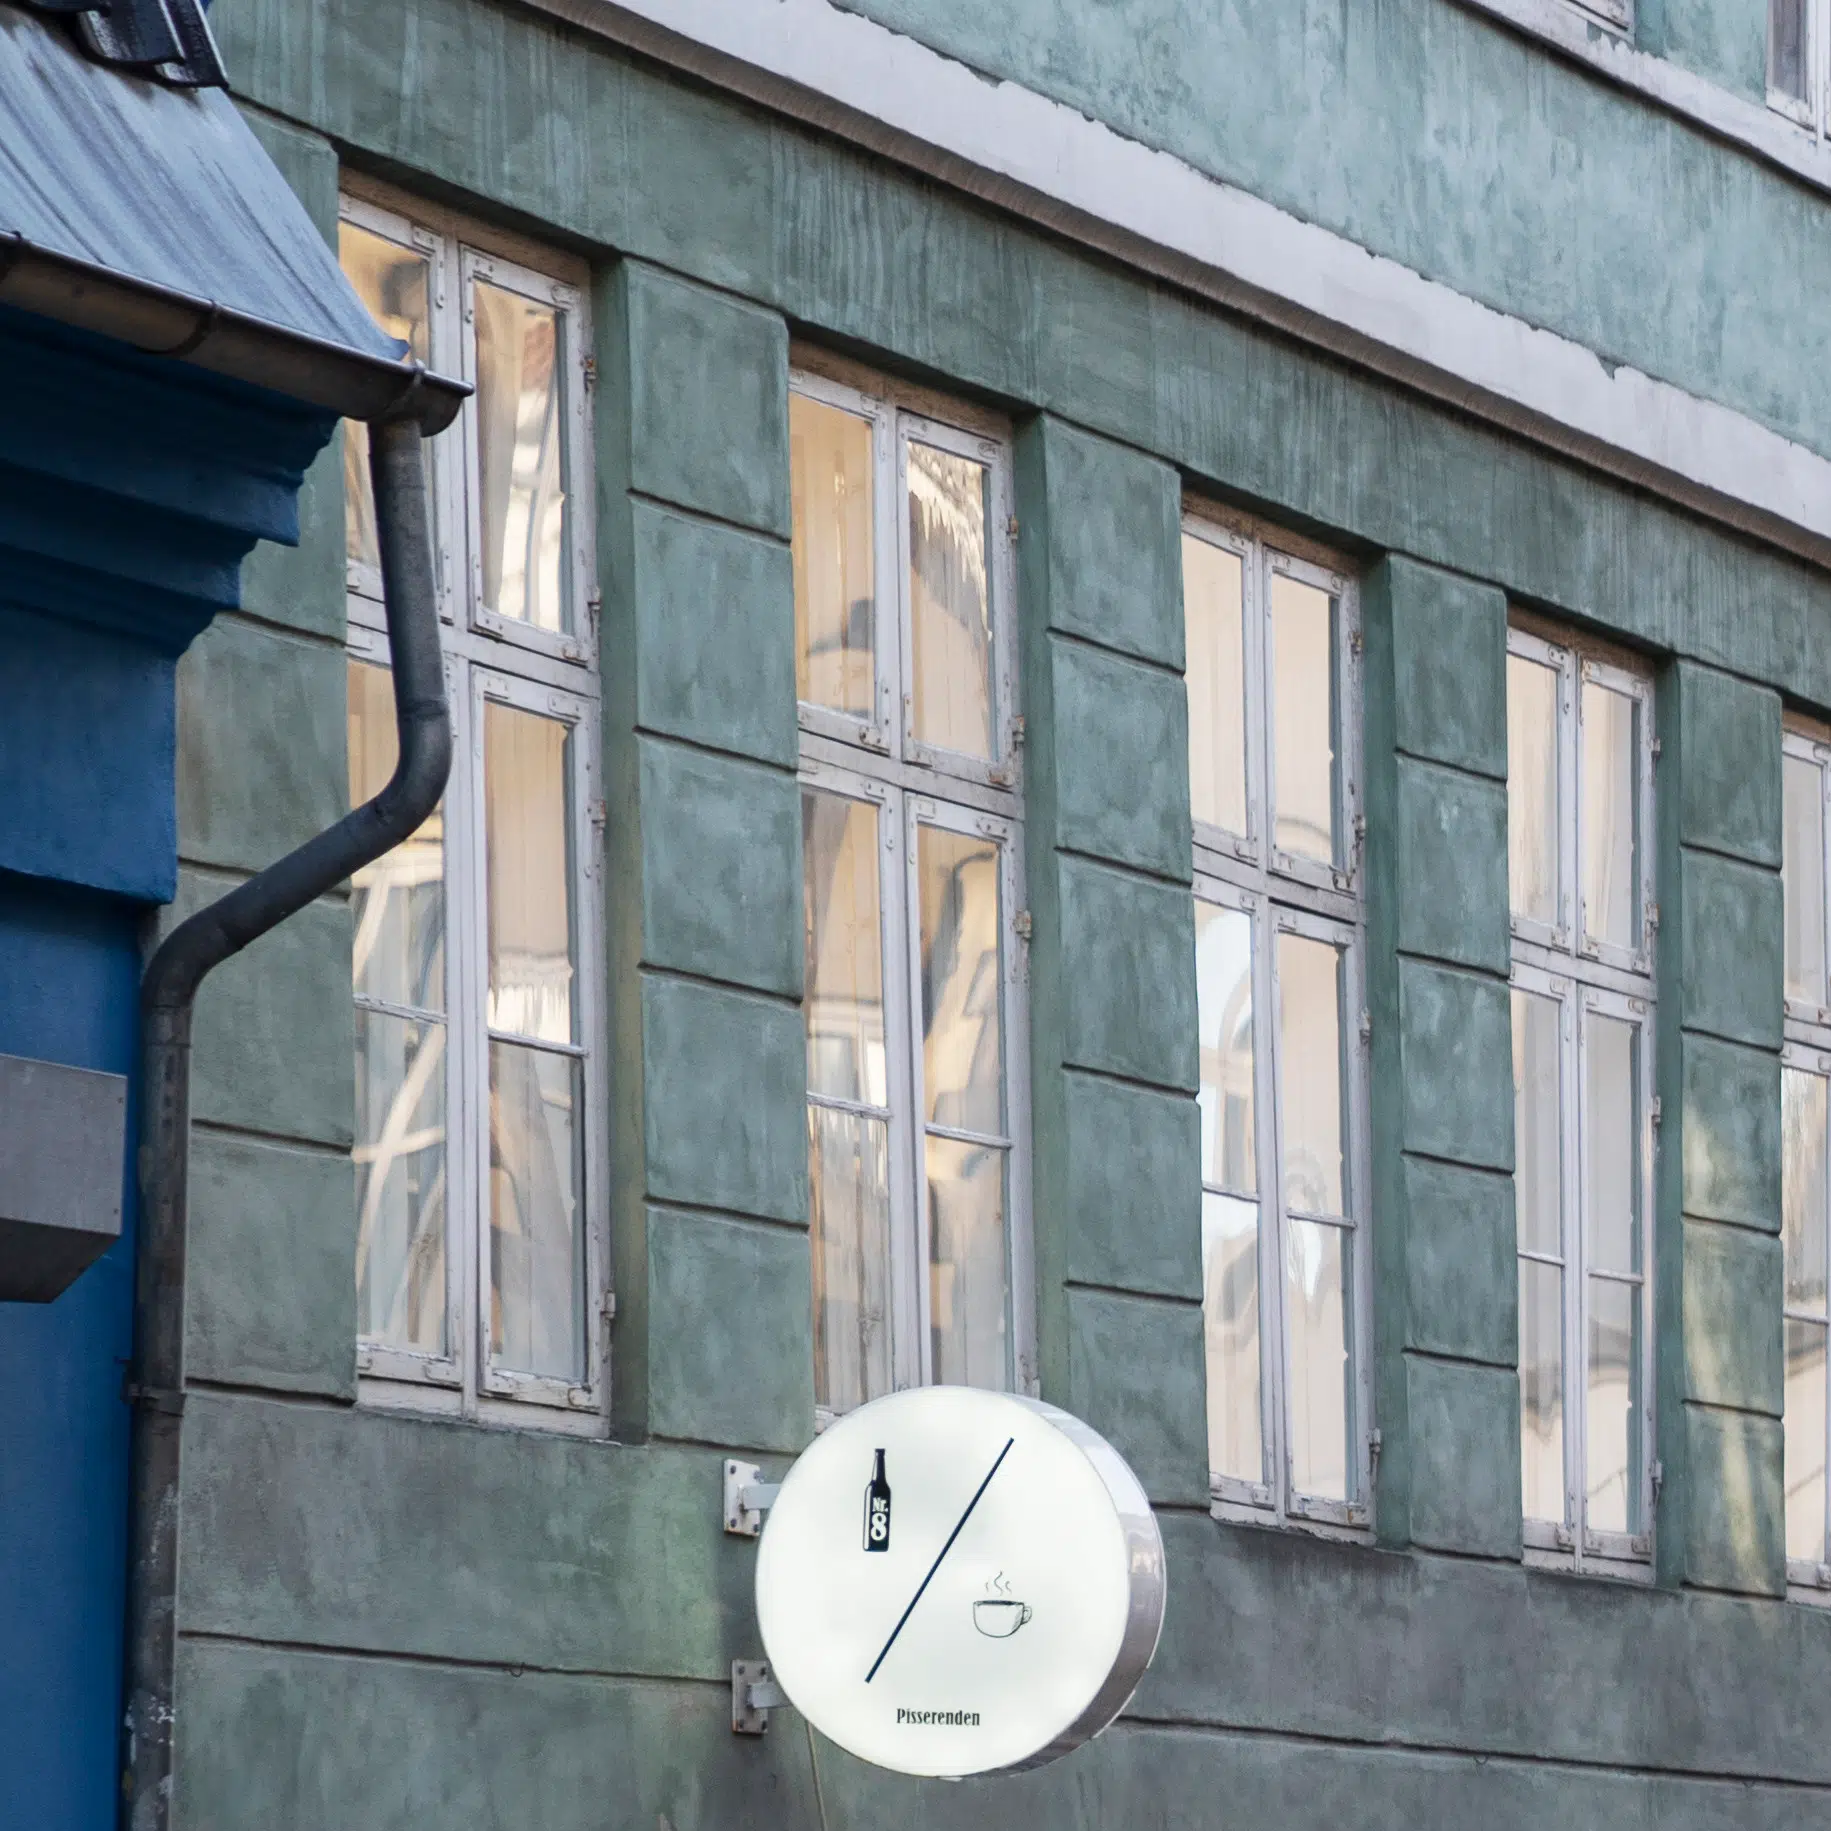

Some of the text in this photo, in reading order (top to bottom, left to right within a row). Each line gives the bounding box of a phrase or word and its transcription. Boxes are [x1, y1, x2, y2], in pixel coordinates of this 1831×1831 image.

[872, 1496, 889, 1513] Nr.
[871, 1513, 887, 1541] 8
[896, 1708, 980, 1727] Pisserenden
